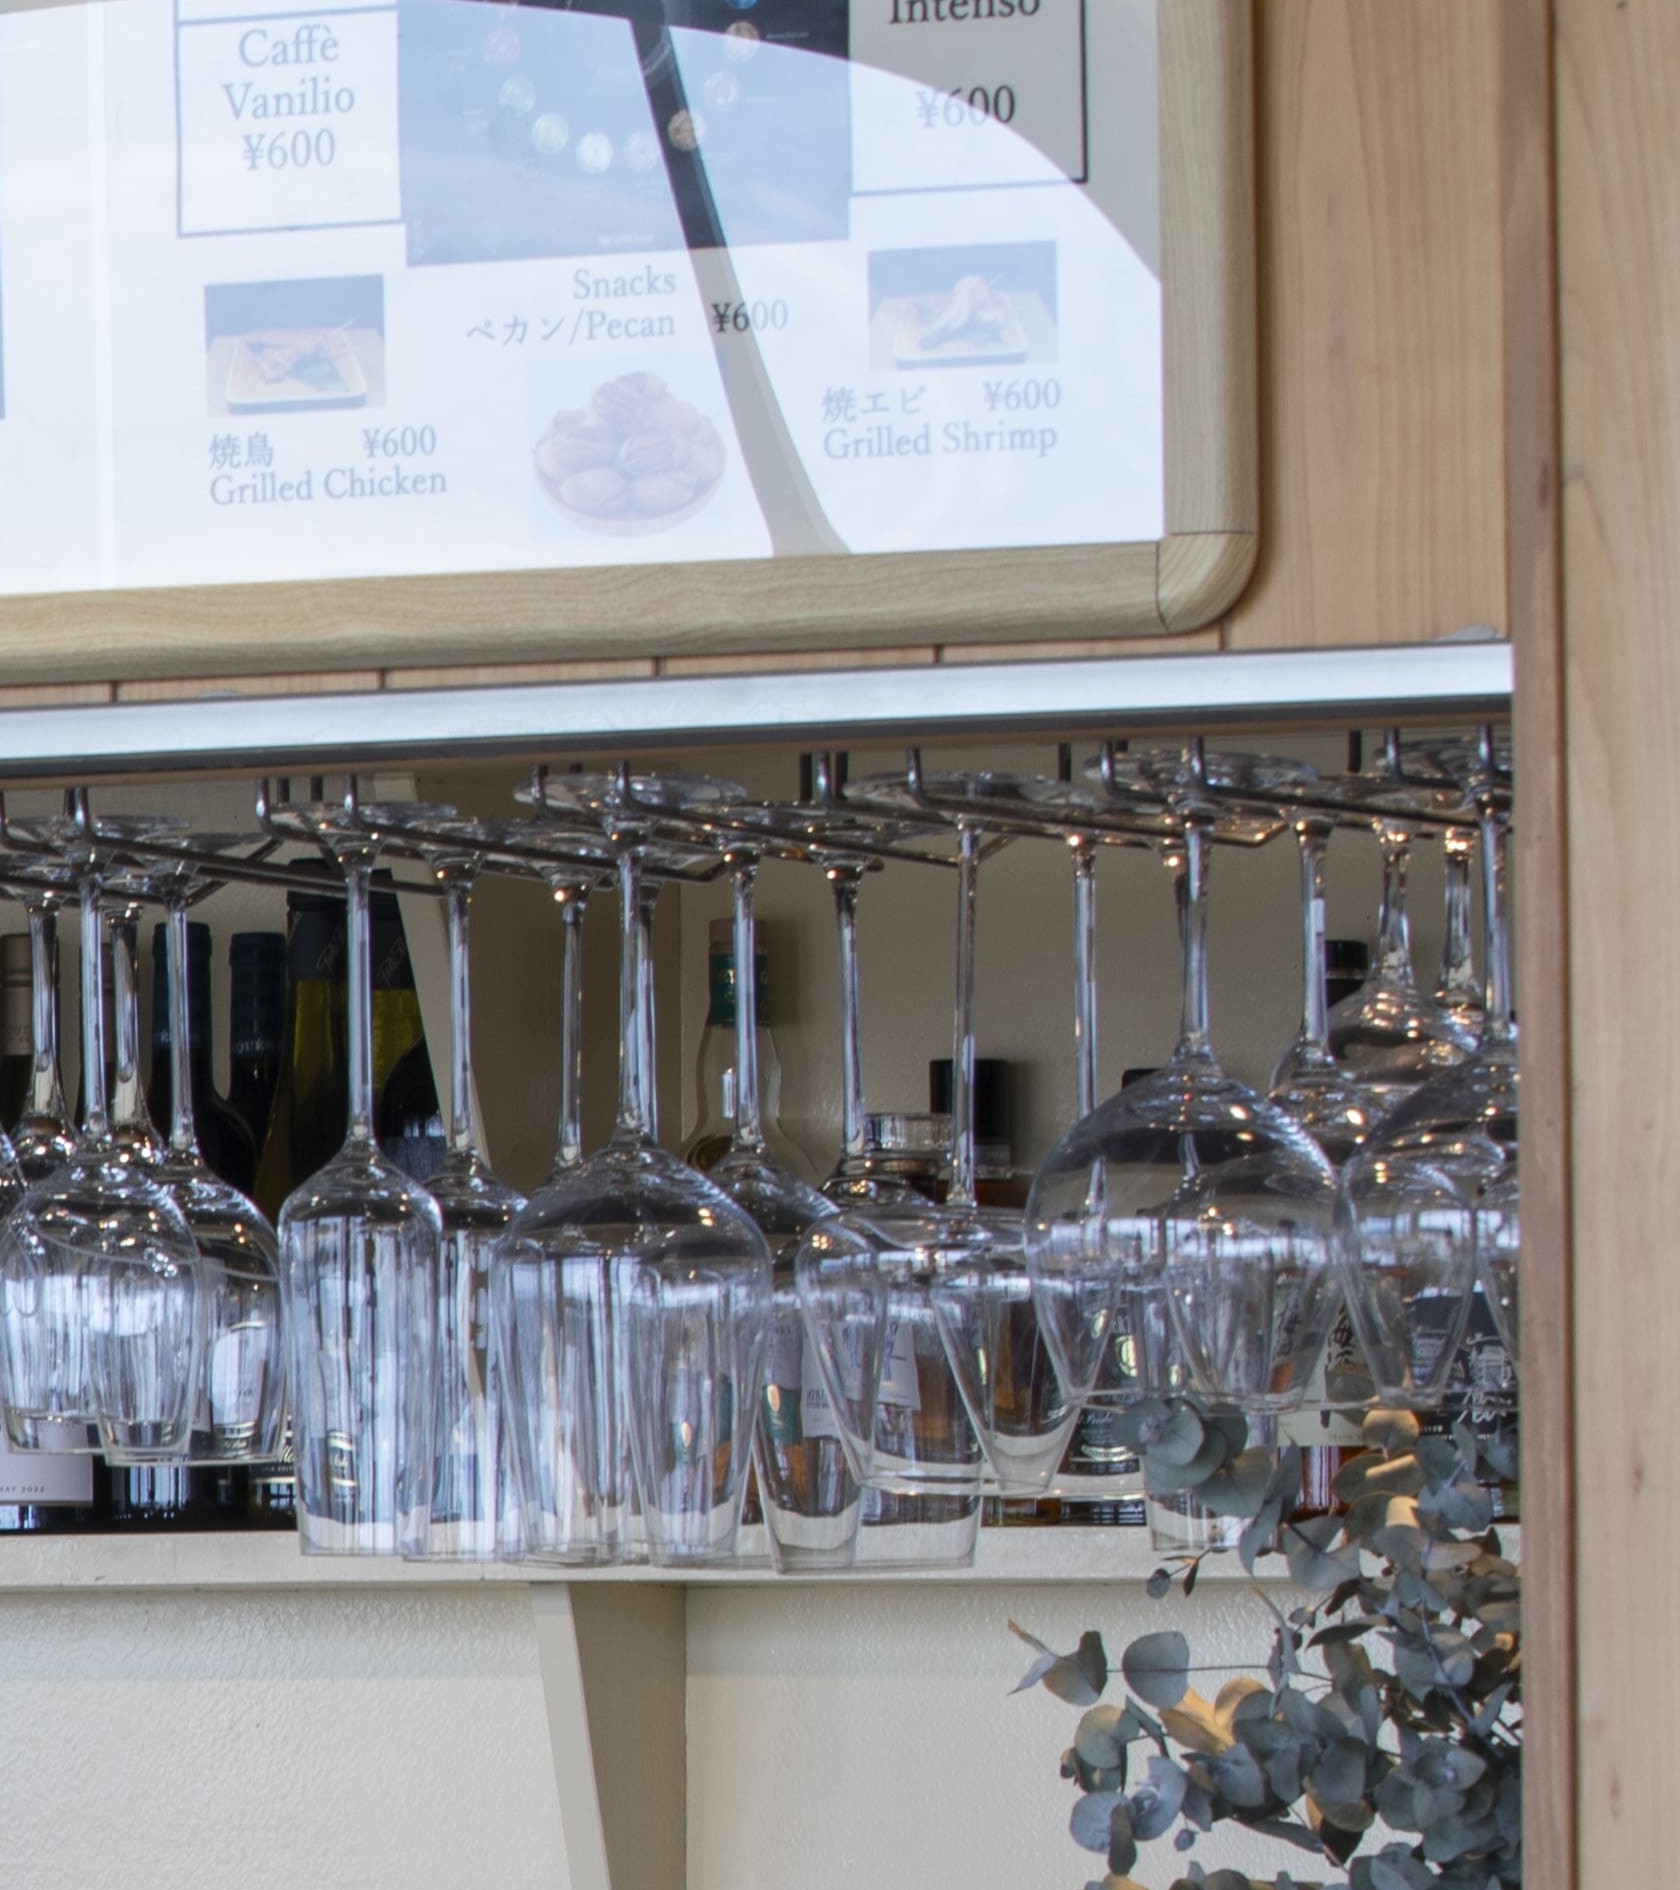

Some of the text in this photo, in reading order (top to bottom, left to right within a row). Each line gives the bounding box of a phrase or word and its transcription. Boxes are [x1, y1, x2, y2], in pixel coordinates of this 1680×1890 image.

[238, 24, 339, 67] Caffè
[221, 75, 355, 120] Vanilio
[914, 84, 1016, 129] ¥600
[242, 128, 335, 170] ¥600
[573, 264, 676, 300] Snacks
[712, 298, 790, 334] ¥600
[822, 378, 1061, 423] 焼エビ ¥600
[208, 425, 436, 470] 焼鳥 ¥600
[824, 420, 1057, 459] Grilled Shrimp
[210, 464, 446, 505] Grilled Chicken
